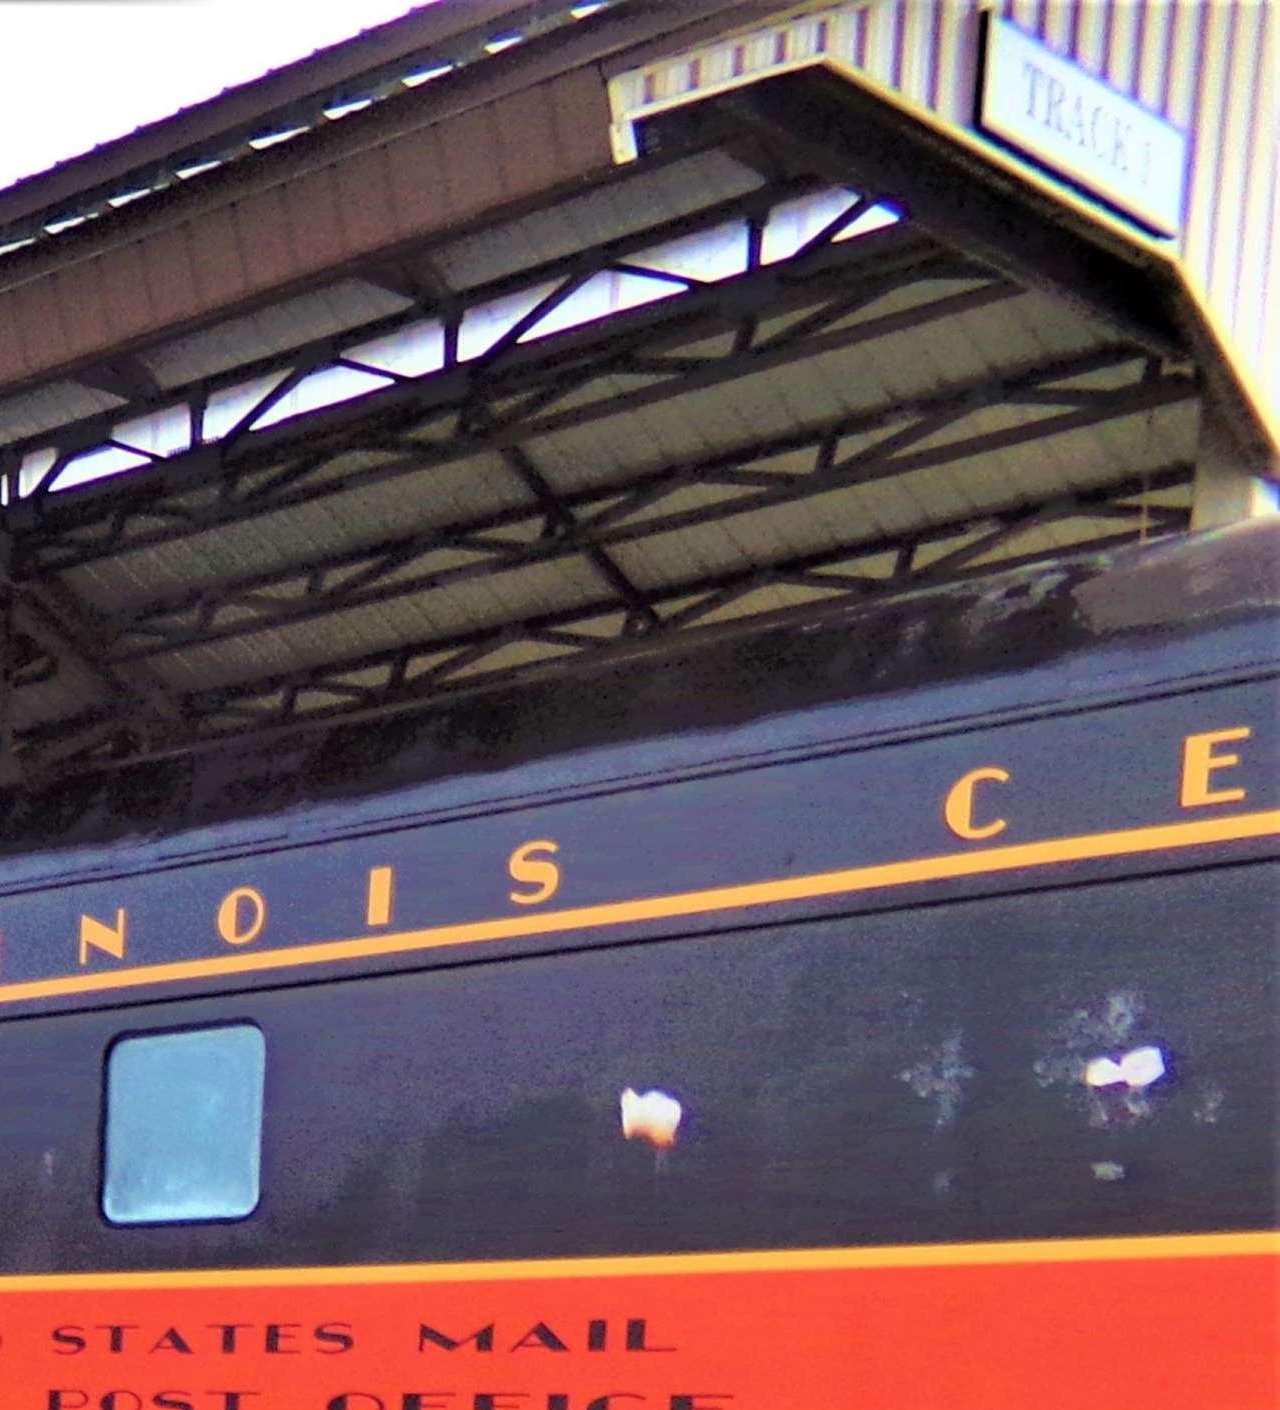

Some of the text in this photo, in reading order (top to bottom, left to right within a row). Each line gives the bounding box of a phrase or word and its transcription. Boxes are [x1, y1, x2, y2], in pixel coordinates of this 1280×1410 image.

[1022, 61, 1132, 173] TRACK
[51, 1322, 355, 1356] STATES
[418, 1318, 678, 1354] MAIL
